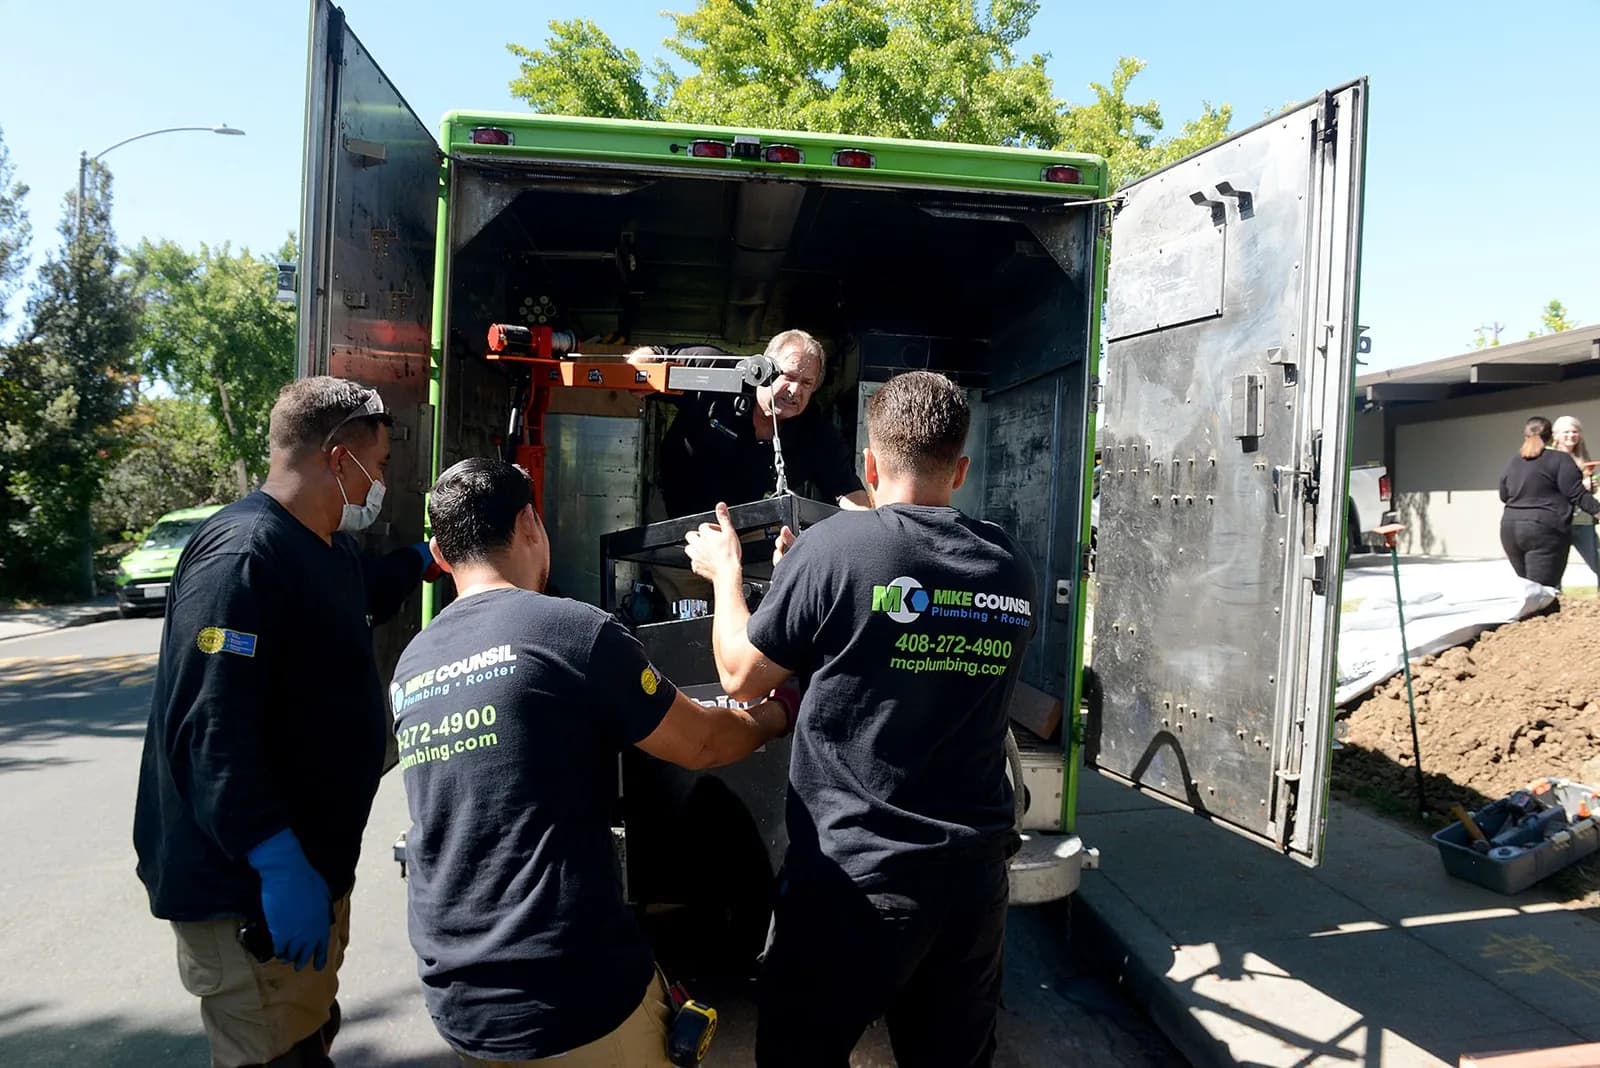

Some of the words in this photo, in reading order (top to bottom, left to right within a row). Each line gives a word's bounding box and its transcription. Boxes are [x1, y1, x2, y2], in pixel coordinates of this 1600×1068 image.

[931, 606, 989, 623] Plumbing
[1000, 613, 1031, 627] Rooter
[933, 589, 974, 607] MIKE
[974, 592, 1032, 617] COUNSIL
[895, 632, 1013, 659] 408-272-4900
[405, 668, 436, 697] MIKE
[435, 644, 517, 682] COUNSIL
[465, 665, 517, 686] Rooter
